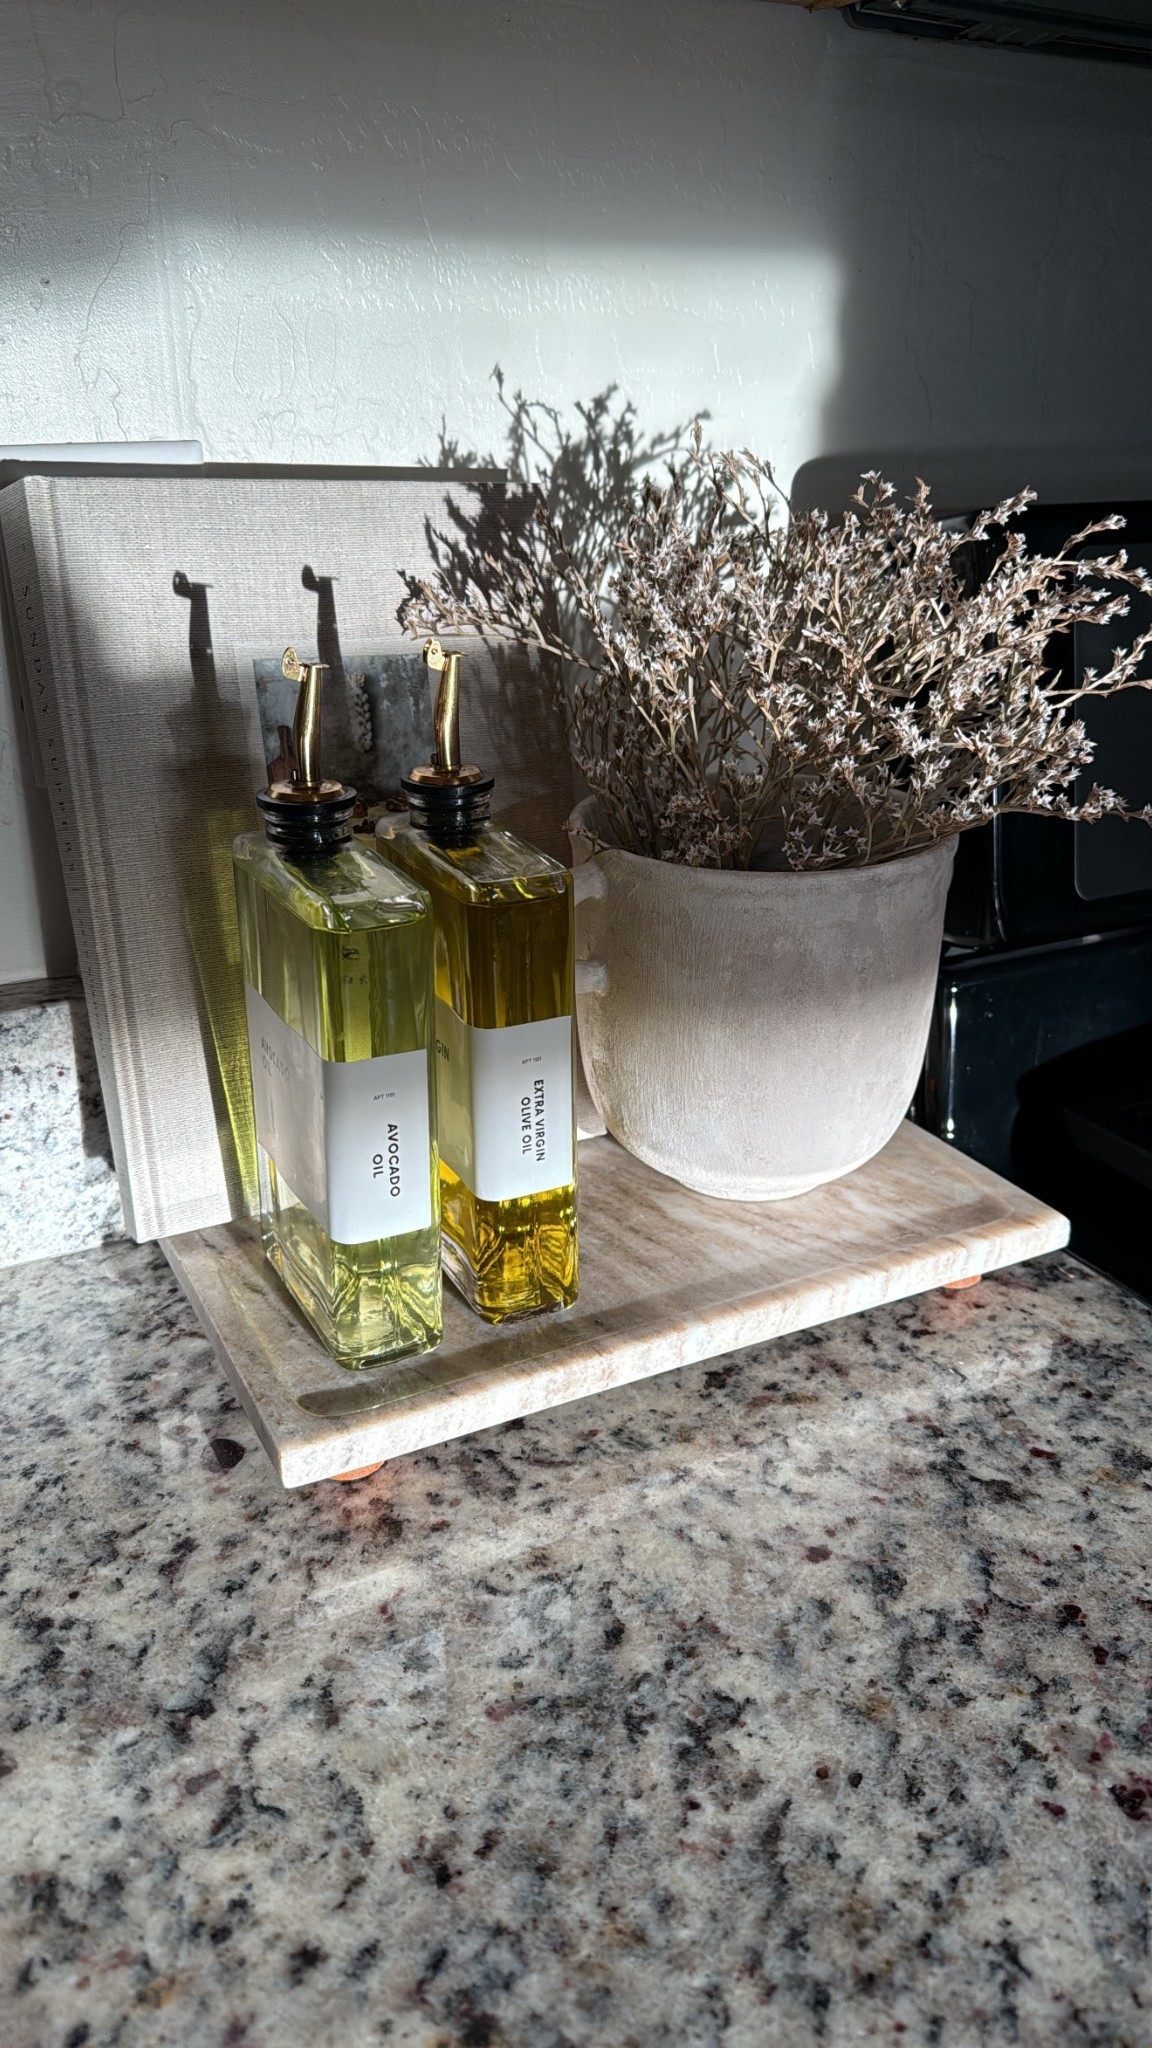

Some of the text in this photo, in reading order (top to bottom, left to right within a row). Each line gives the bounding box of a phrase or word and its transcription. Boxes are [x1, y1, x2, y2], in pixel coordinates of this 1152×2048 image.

[436, 1039, 450, 1062] GIN
[520, 1096, 532, 1155] OLIVE OIL
[534, 1079, 546, 1162] EXTRA VIRGIN
[372, 1153, 384, 1179] OIL
[387, 1124, 401, 1197] AVOCADO
